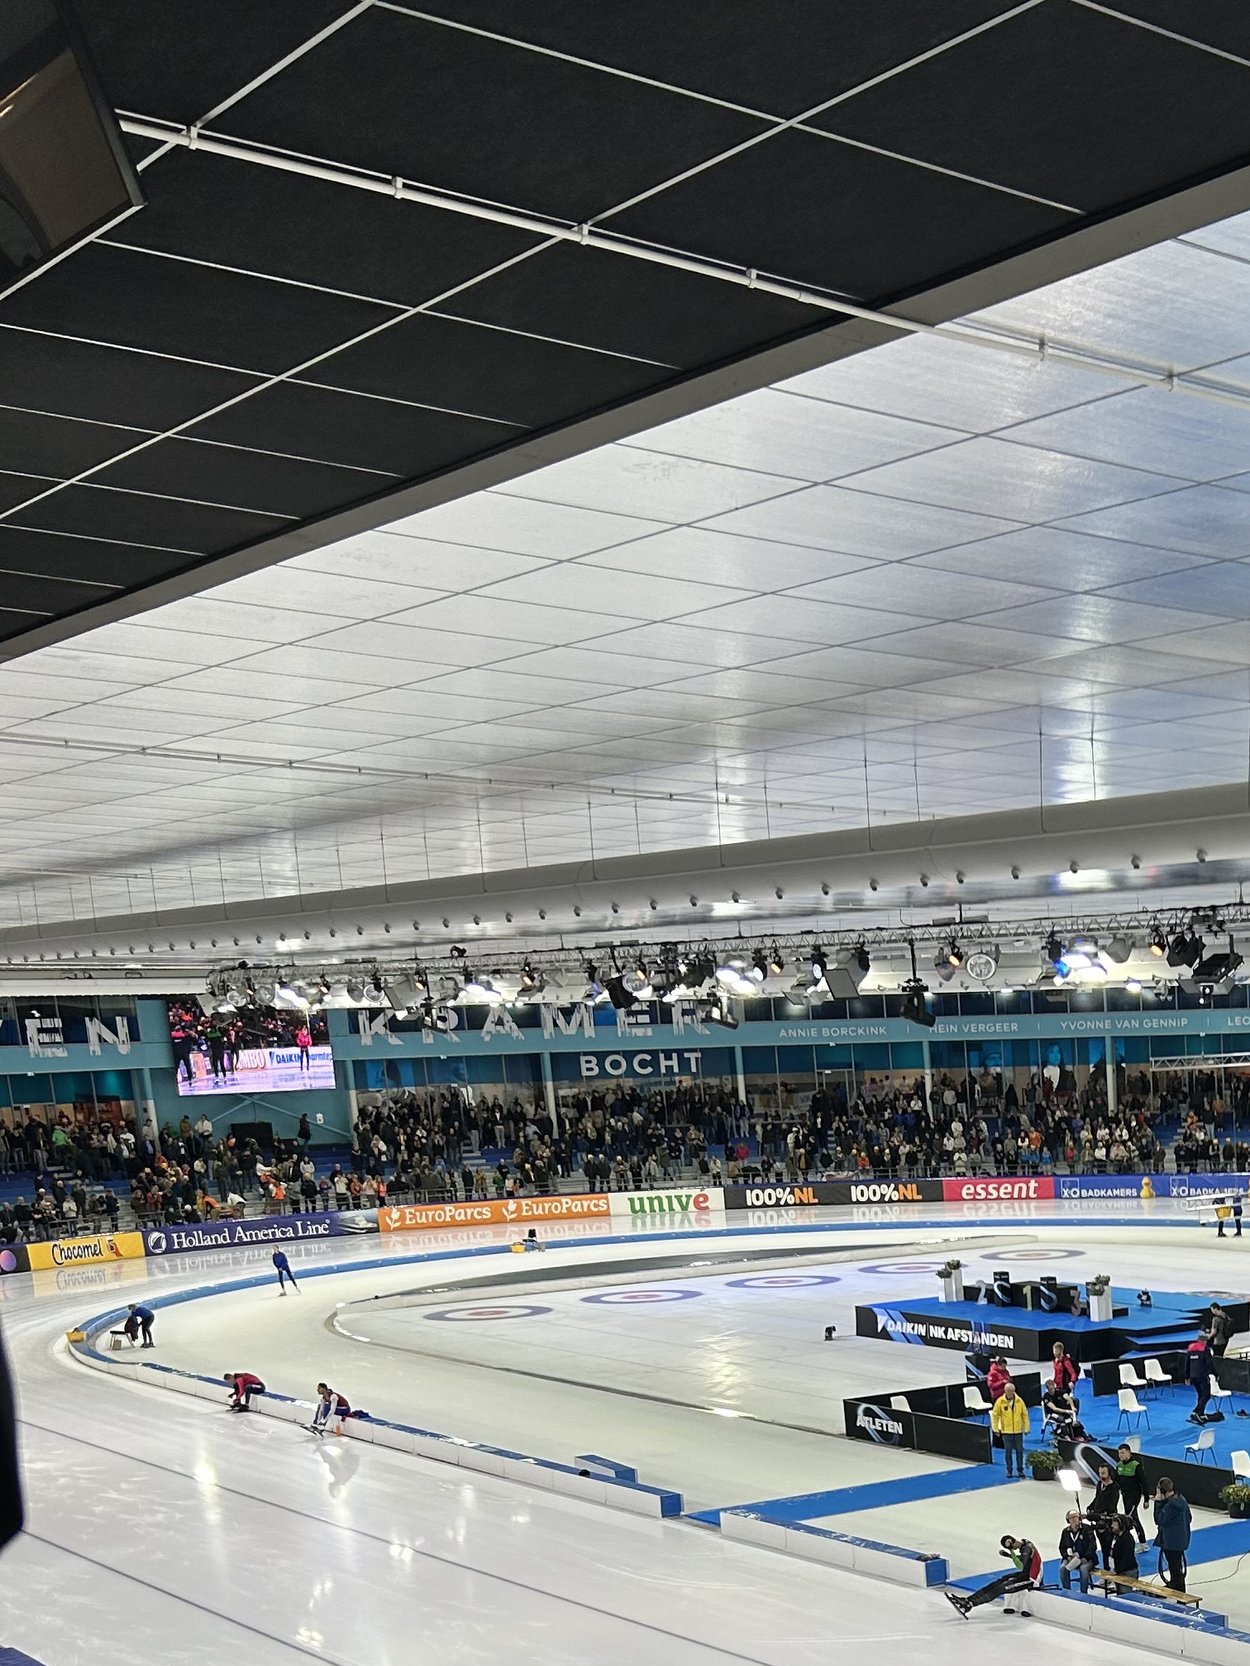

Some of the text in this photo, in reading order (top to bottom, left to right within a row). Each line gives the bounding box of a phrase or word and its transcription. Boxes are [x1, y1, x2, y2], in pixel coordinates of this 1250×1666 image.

[929, 1022, 1019, 1034] HEIN VERGEER
[1060, 1017, 1188, 1030] YVONNE VAN GENNIP
[1228, 1015, 1250, 1026] LEO
[779, 1026, 887, 1038] ANNIE BORCKINK
[580, 1052, 701, 1077] BOCHT
[746, 1187, 818, 1206] 100%NL
[850, 1183, 922, 1202] 100%NL
[961, 1180, 1038, 1200] essent
[1062, 1188, 1138, 1199] XO BADKAMERS
[1171, 1186, 1189, 1197] XO
[404, 1206, 491, 1225] EuroParcs
[521, 1197, 607, 1217] EuroParcs
[172, 1228, 230, 1250] Holland
[232, 1224, 294, 1244] America
[51, 1238, 104, 1266] Chocomel
[1023, 1284, 1033, 1311] 1
[886, 1320, 1014, 1349] DAIKIN NK AFSTANDEN
[856, 1415, 903, 1435] ATLETEN
